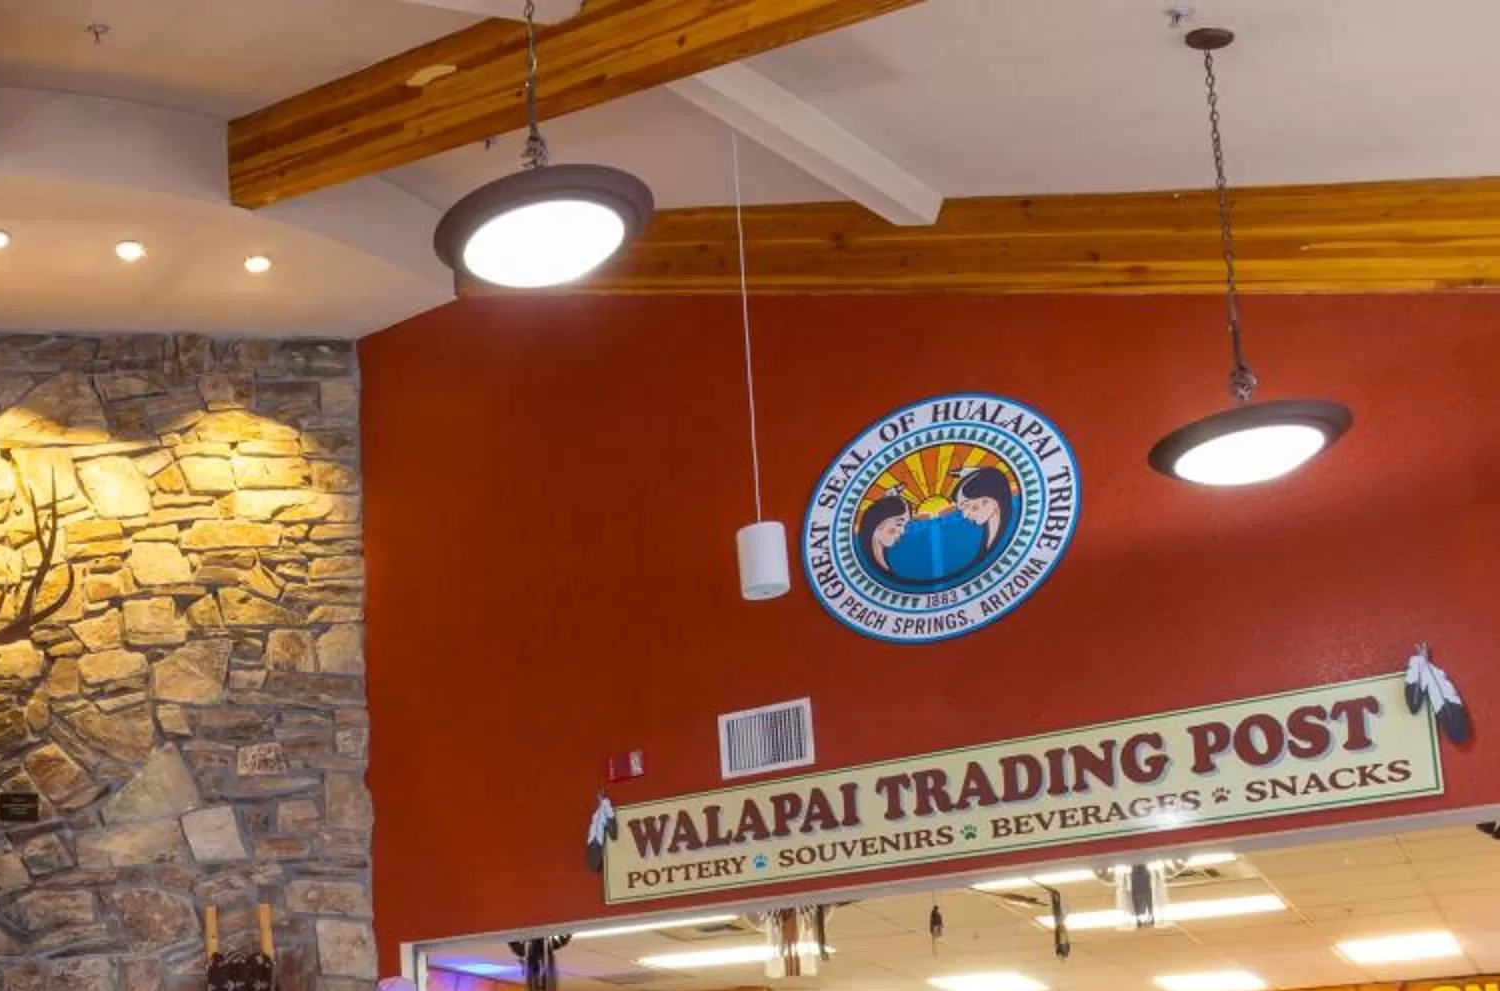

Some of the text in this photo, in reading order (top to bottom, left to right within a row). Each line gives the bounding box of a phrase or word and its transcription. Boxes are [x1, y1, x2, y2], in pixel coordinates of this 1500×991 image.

[809, 400, 1073, 600] GREAT SEAL OF HUALAPAI TRIBE
[839, 596, 888, 631] PEACH
[980, 557, 1048, 617] ARIZONA
[627, 696, 1381, 859] WALAPAI TRADING POST
[627, 758, 1413, 889] POTTERY SOUVENIRS BEVERAGES SNACKS
